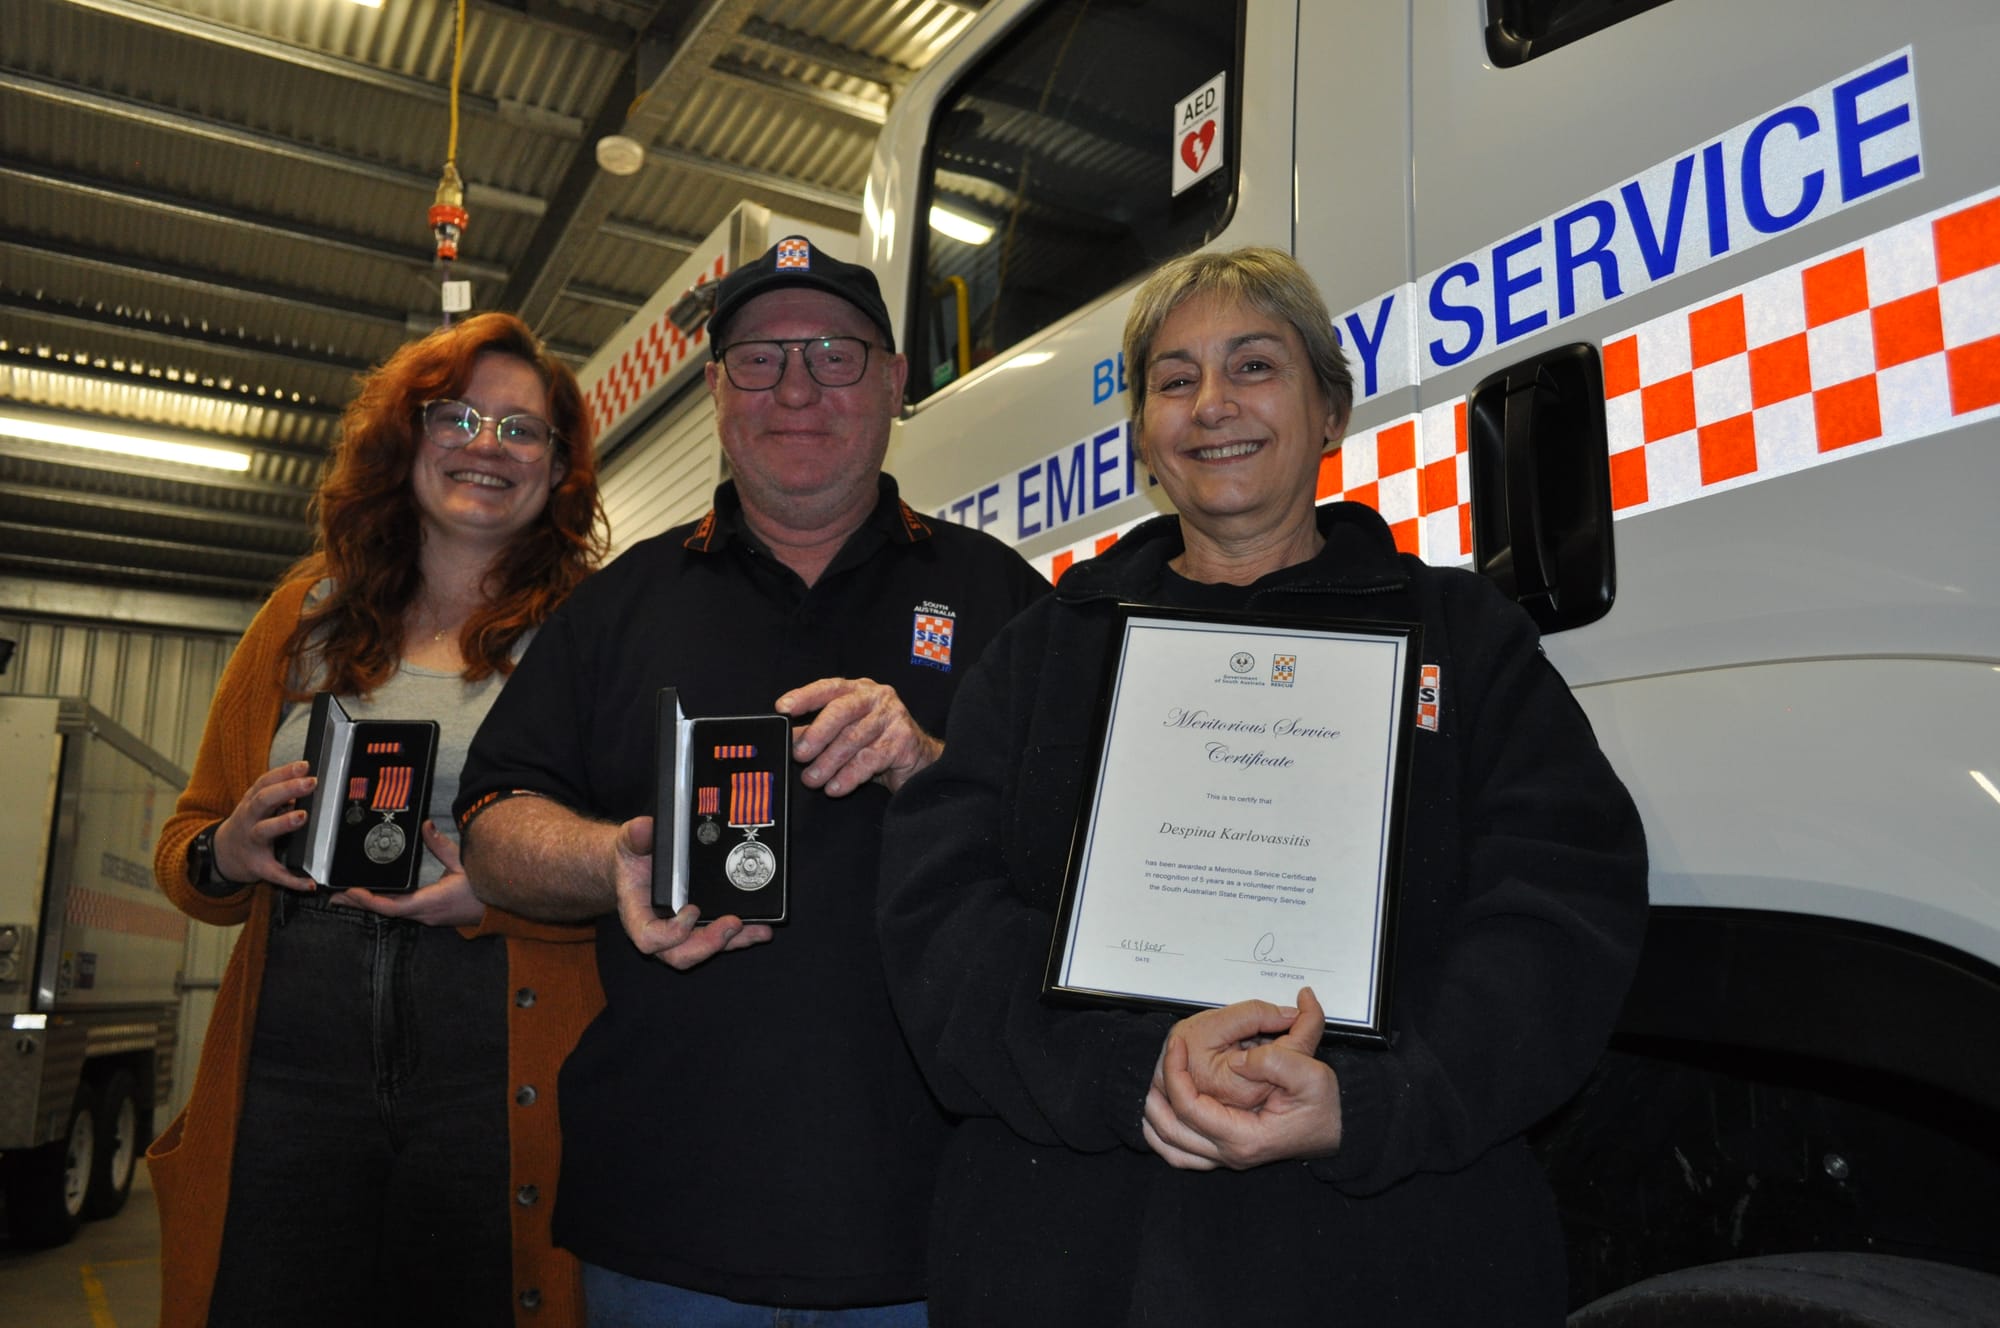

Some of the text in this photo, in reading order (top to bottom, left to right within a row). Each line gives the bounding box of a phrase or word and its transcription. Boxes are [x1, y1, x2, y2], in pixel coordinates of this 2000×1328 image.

[1183, 87, 1216, 125] AED
[1428, 54, 1921, 367] SERVICE
[913, 605, 956, 617] AUSTRALIA
[923, 600, 949, 611] SOUTH
[916, 629, 950, 647] SES
[1274, 664, 1294, 673] SES
[1163, 706, 1341, 740] Meritorious Service
[1204, 741, 1296, 772] Certificate
[1206, 792, 1220, 800] This
[1237, 796, 1258, 805] certify
[1258, 797, 1272, 805] that
[1159, 821, 1311, 848] Despina Karlovassitis
[1145, 859, 1157, 867] has
[1159, 860, 1176, 868] been
[1178, 862, 1207, 872] awarded
[1214, 865, 1253, 876] Meritorious
[1254, 869, 1280, 878] Service
[1281, 872, 1317, 882] Certificate
[1152, 872, 1190, 882] recognition
[1206, 878, 1225, 886] years
[1243, 880, 1275, 890] volunteer
[1276, 884, 1305, 893] member
[1149, 883, 1306, 906] the South Australian State Emergency Service
[1135, 955, 1150, 963] DATE
[1279, 972, 1305, 980] OFFICER
